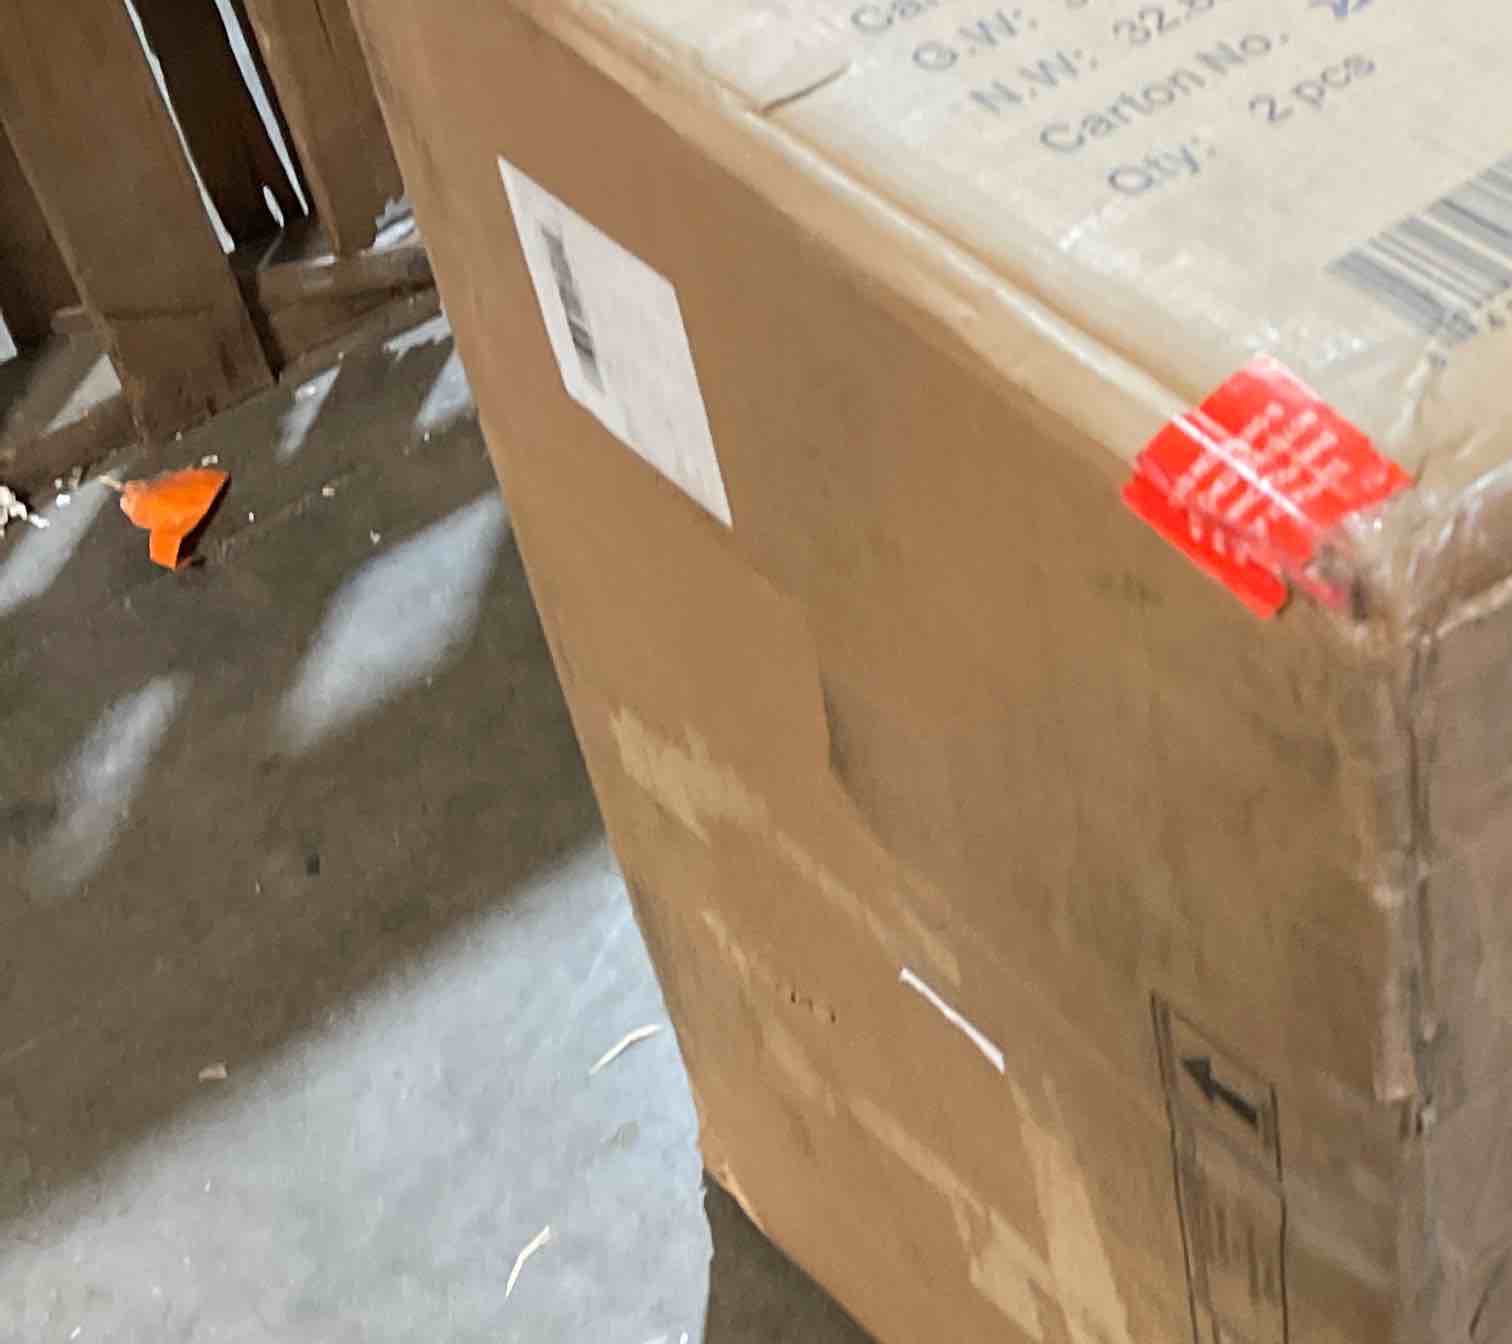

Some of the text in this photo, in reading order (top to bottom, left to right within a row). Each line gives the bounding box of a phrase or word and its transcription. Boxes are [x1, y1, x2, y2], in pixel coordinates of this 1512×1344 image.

[970, 49, 1099, 116] N.W:
[1040, 67, 1200, 154] Carton
[1195, 30, 1291, 77] No.
[1107, 53, 1377, 197] Qty: 2 pcs
